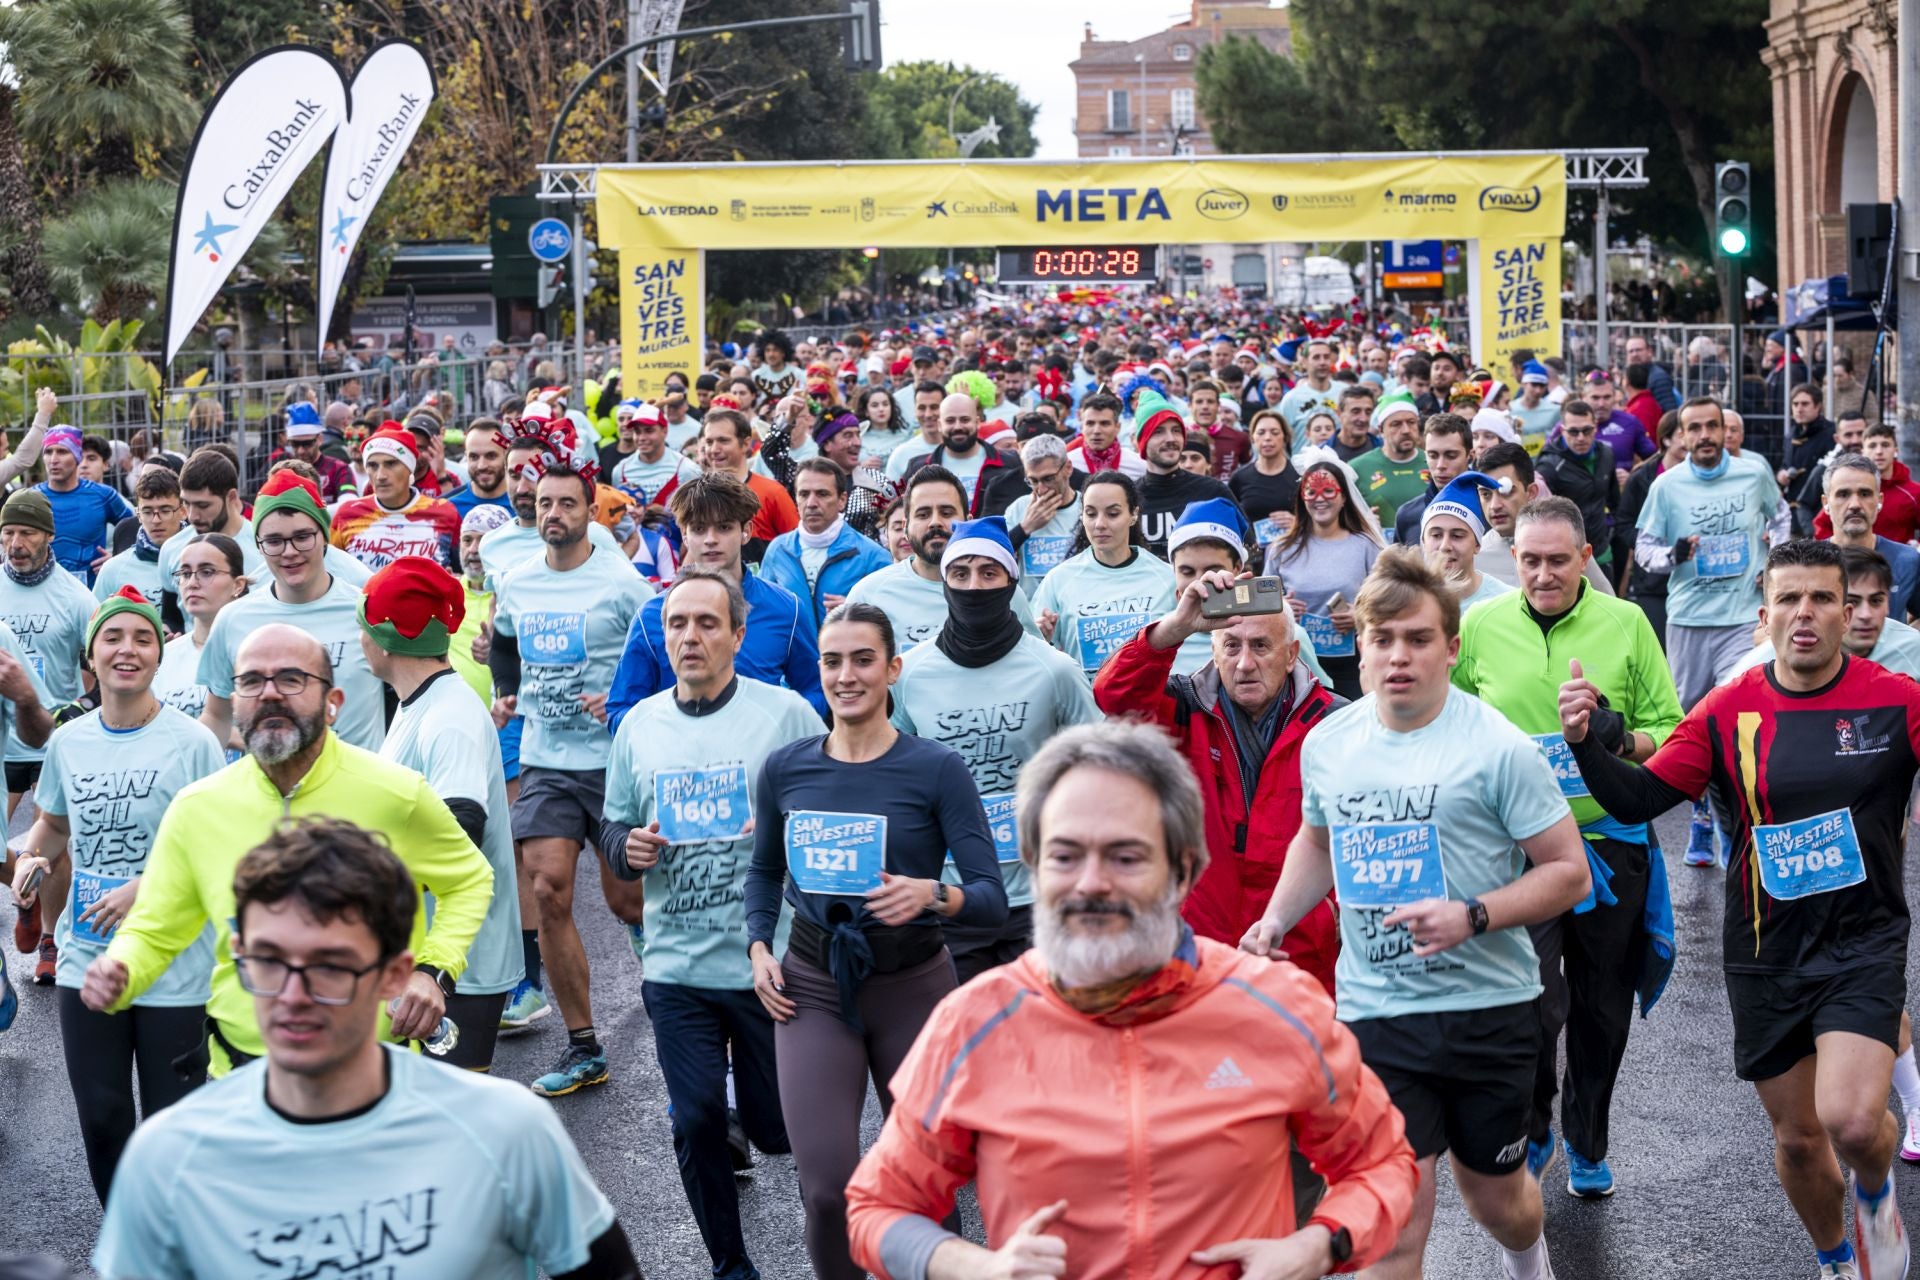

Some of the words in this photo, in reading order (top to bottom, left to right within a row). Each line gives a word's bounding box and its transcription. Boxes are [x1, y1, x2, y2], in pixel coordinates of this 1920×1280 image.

[223, 97, 322, 211] CaixaBank
[346, 91, 420, 203] CaixaBank
[637, 206, 657, 216] LA
[659, 206, 719, 216] VERDAD
[952, 200, 1020, 214] CaixaBank
[1036, 187, 1172, 222] META
[1202, 199, 1244, 211] Juver
[1399, 193, 1457, 205] marmo
[1488, 193, 1533, 205] VIDAL
[1033, 250, 1140, 275] 0:00:28
[1407, 254, 1431, 267] 24h
[1493, 242, 1546, 270] SAN
[633, 258, 686, 285] SAN
[1502, 264, 1538, 288] SIL
[642, 279, 678, 303] SIL
[1497, 281, 1543, 307] VES
[638, 297, 684, 322] VES
[1498, 302, 1546, 328] TRE
[639, 317, 686, 342] TRE
[1496, 320, 1549, 341] MURCIA
[638, 335, 690, 355] MURCIA
[637, 362, 650, 370] LA
[651, 361, 689, 369] VERDAD
[1435, 504, 1468, 518] marmo
[0, 614, 50, 635] AN
[524, 613, 547, 626] SAN
[524, 614, 580, 637] SILVESTRE
[1083, 618, 1108, 634] SAN
[1084, 615, 1145, 642] SILVESTRE
[533, 634, 569, 651] 680
[936, 702, 1030, 742] SAN
[71, 769, 159, 804] SAN
[662, 773, 694, 793] SAN
[663, 770, 738, 806] SILVESTRE
[707, 784, 738, 800] MURCIA
[671, 798, 732, 823] 1605
[1337, 783, 1440, 824] SAN
[77, 801, 139, 836] SIL
[793, 817, 824, 834] SAN
[792, 820, 878, 849] SILVESTRE
[836, 834, 875, 848] MURCIA
[1341, 828, 1375, 849] SAN
[1342, 826, 1430, 864] SILVESTRE
[1765, 828, 1791, 848] SAN
[1767, 814, 1844, 861] SILVESTRE
[1811, 830, 1845, 849] MURCIA
[74, 831, 150, 867] VES
[803, 847, 858, 872] 1321
[1392, 842, 1430, 860] MURCIA
[1351, 858, 1424, 884] 2877
[1774, 846, 1844, 879] 3708
[78, 878, 101, 891] SAN
[660, 855, 739, 895] TRE
[246, 1186, 441, 1280] SAN
